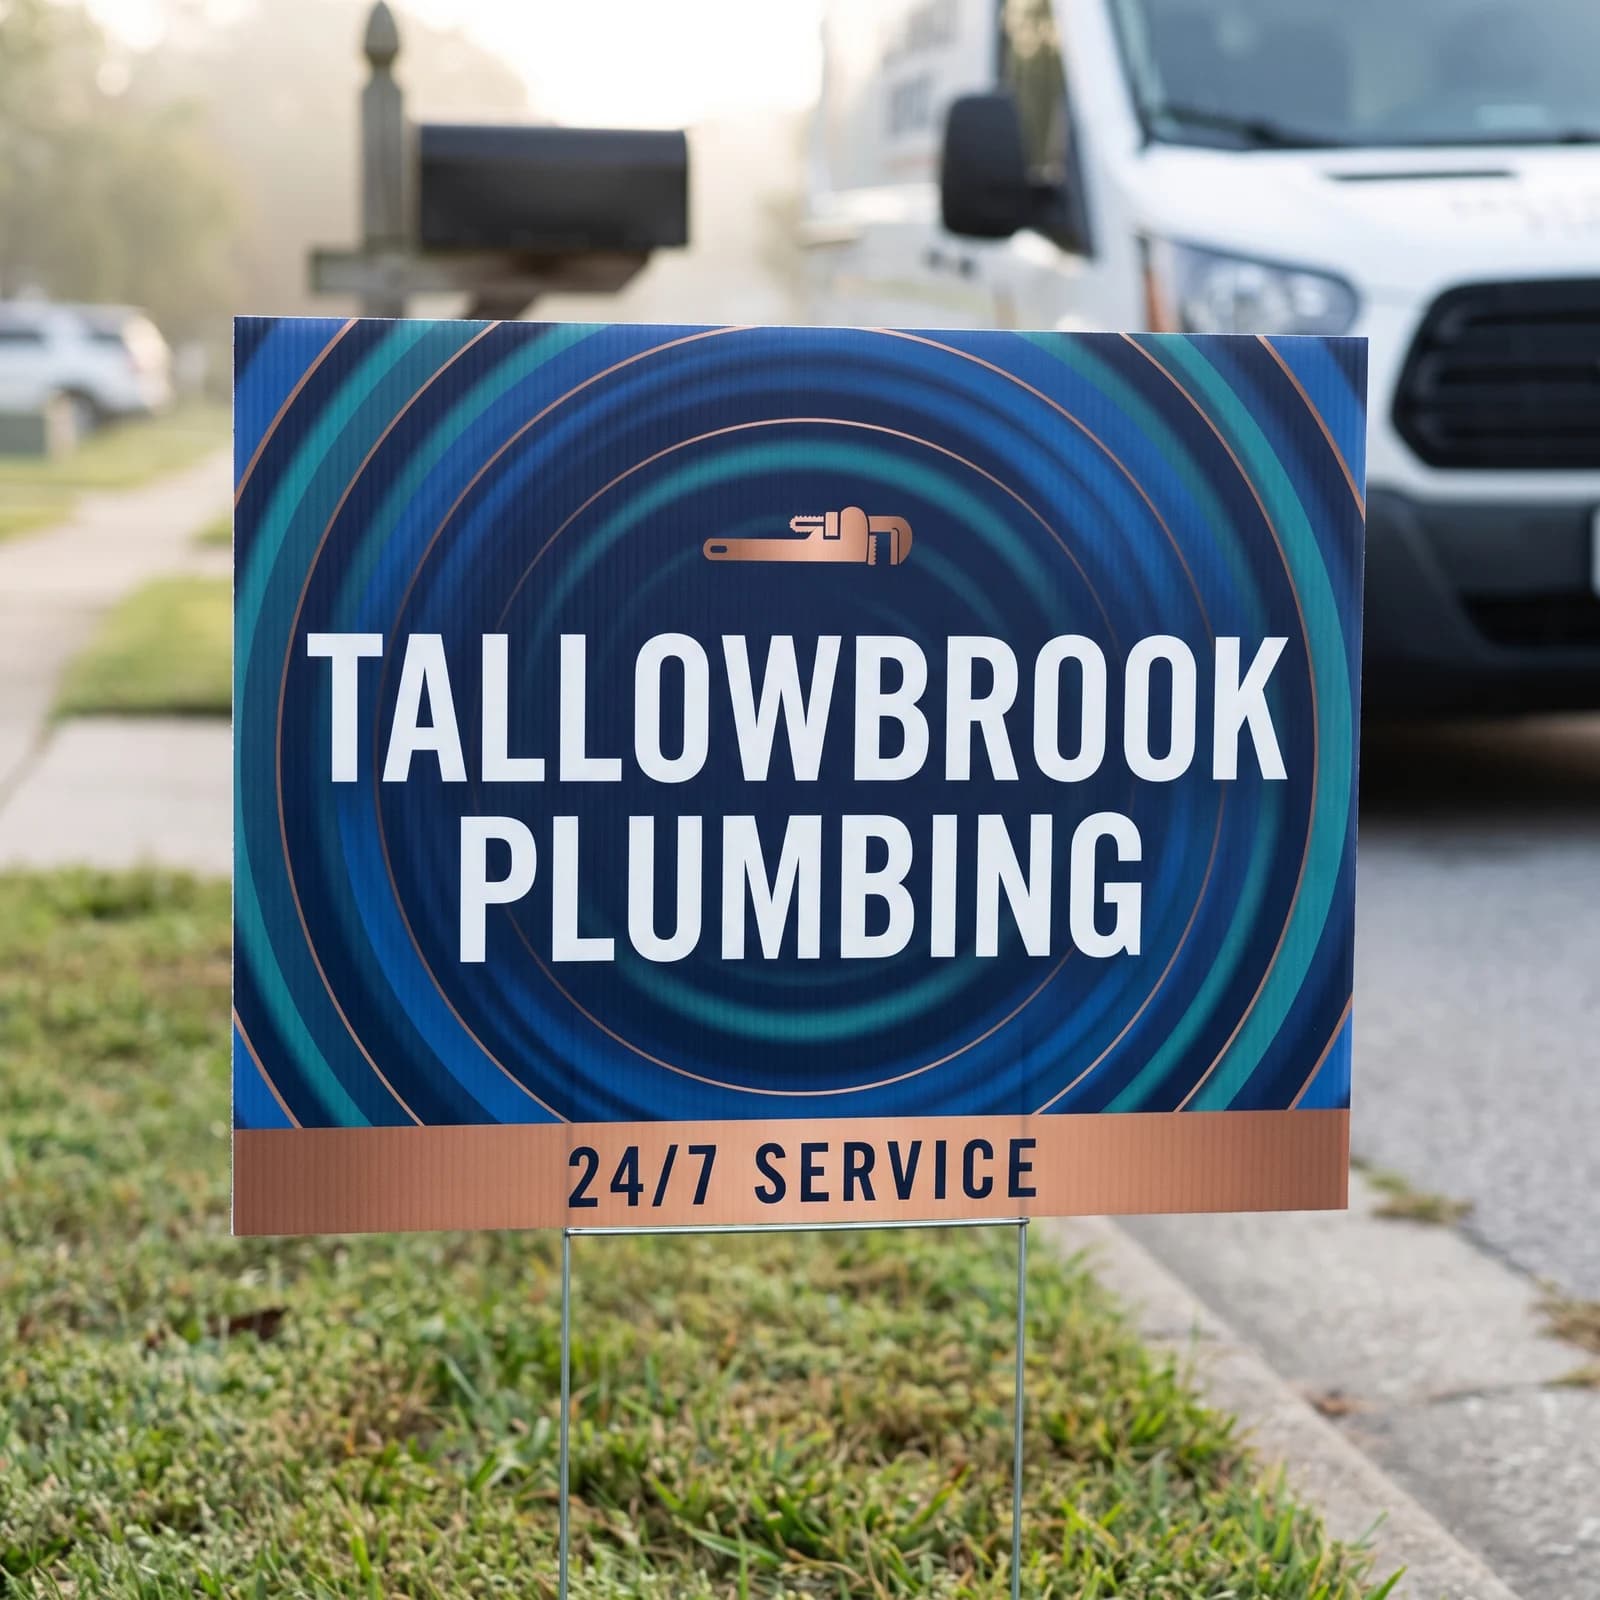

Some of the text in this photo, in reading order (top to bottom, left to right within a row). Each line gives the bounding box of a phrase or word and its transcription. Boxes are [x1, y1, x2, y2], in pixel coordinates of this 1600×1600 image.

[307, 633, 1289, 784] TALLOWBROOK
[460, 811, 1142, 964] PLUMBING
[568, 1137, 1037, 1209] 24/7 SERVICE
